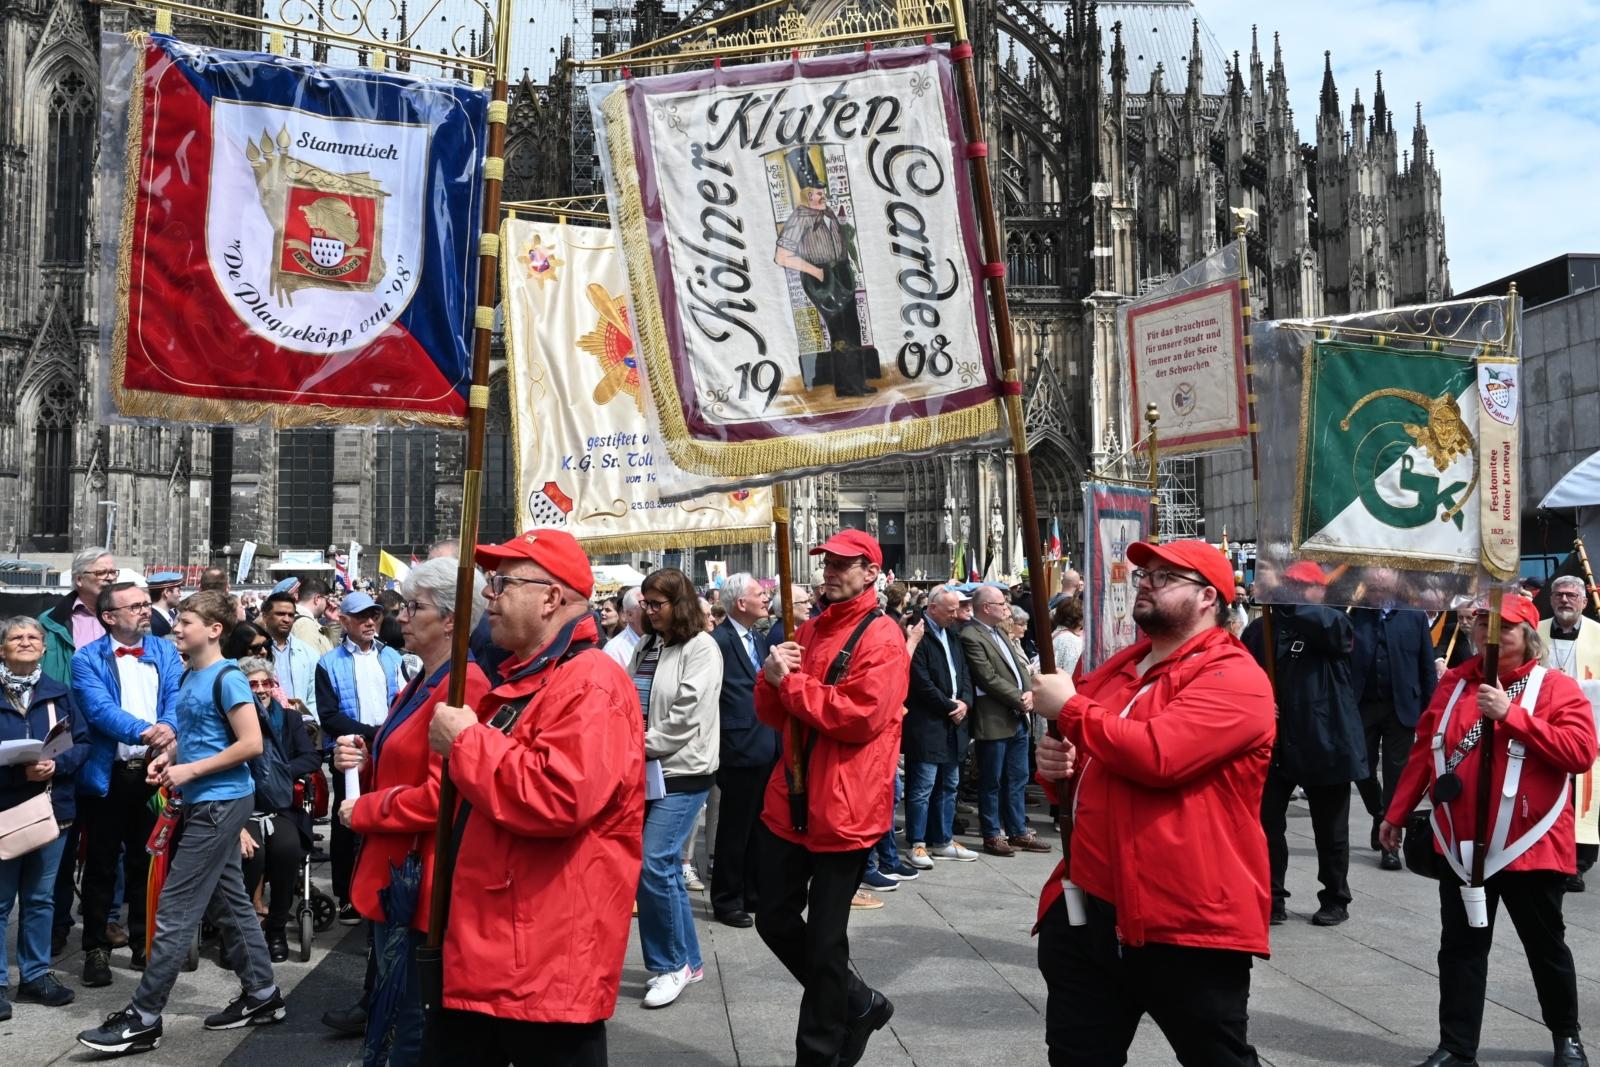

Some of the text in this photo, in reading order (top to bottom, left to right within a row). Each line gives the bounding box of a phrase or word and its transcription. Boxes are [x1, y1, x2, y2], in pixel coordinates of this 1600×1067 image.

[296, 131, 399, 160] Stammtisch
[678, 142, 768, 356] Kölner
[234, 282, 353, 348] Plaggeköpp
[1145, 328, 1222, 356] für unsere Stadt und
[1146, 330, 1159, 341] Für
[1161, 328, 1173, 337] das
[1148, 345, 1218, 367] immer an der Seite
[1155, 360, 1210, 378] der Schwachen
[734, 334, 954, 414] 19 08
[1484, 396, 1510, 421] 200 Jahre
[587, 432, 637, 451] gestiftet
[625, 475, 642, 484] von
[1489, 449, 1499, 512] Festkomitee
[1502, 441, 1511, 521] Kölner Karneval
